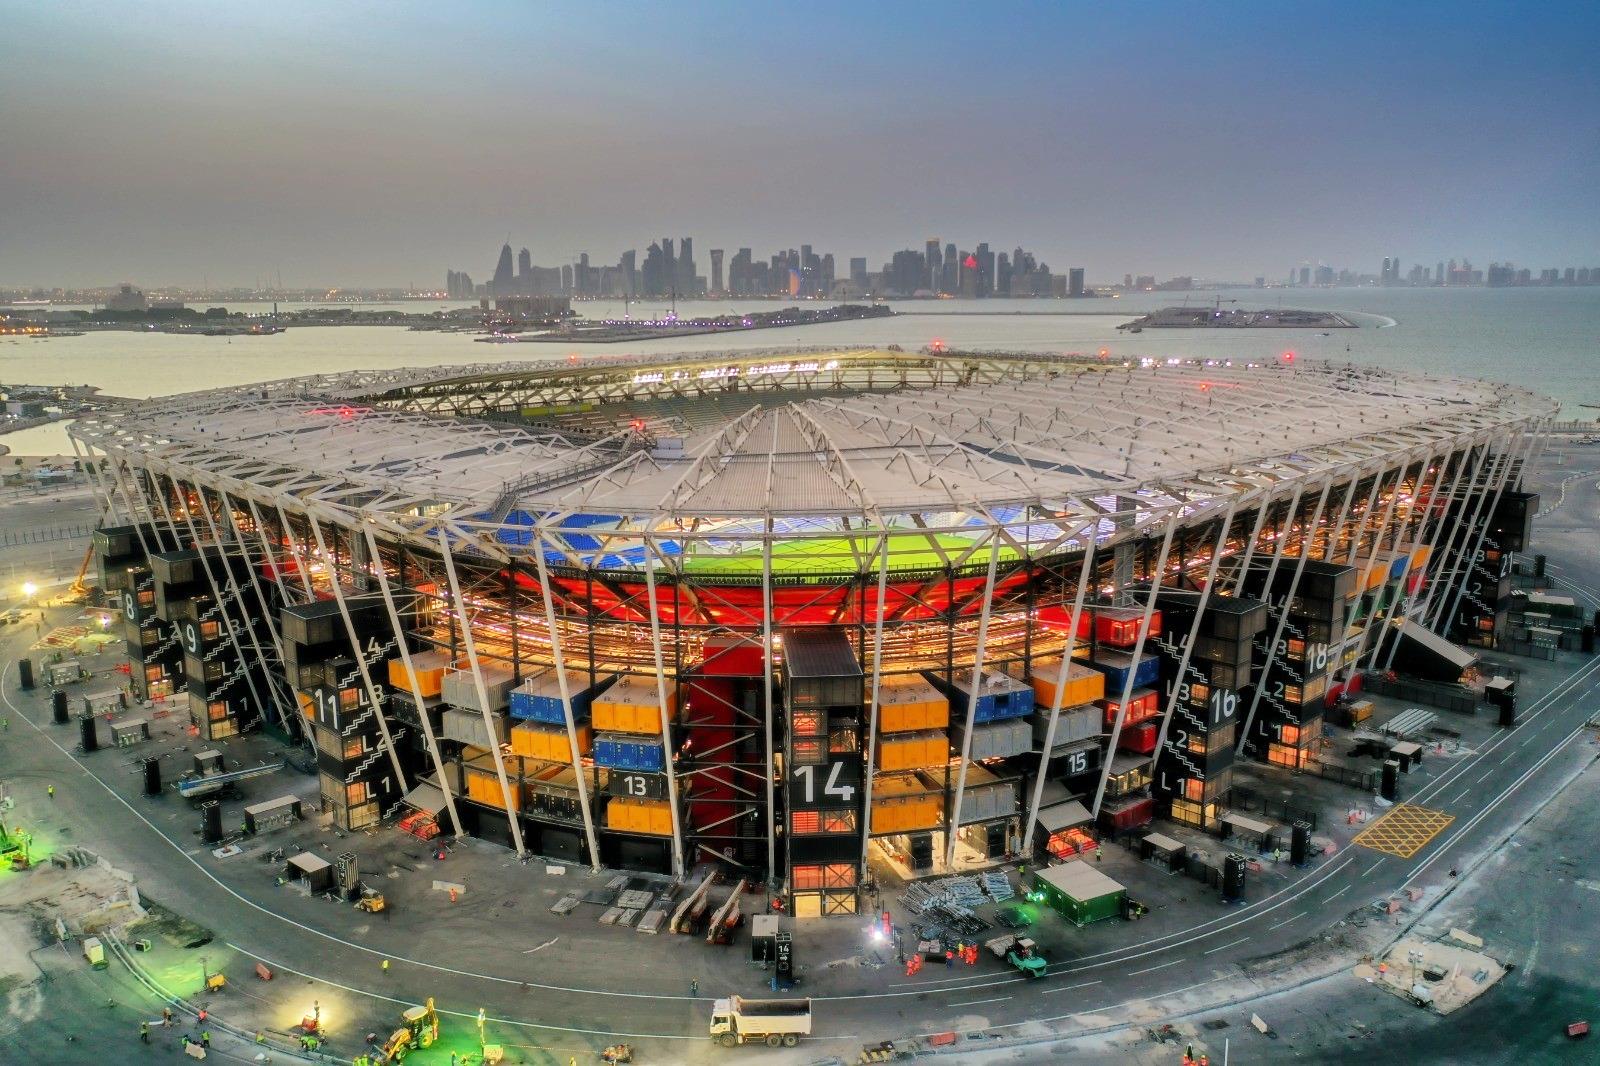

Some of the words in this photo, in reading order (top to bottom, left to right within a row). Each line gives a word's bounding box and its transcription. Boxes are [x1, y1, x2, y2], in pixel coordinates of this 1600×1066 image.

[1501, 551, 1514, 578] 21
[125, 593, 135, 620] 8
[218, 619, 240, 637] L3
[1460, 613, 1480, 627] L1
[186, 623, 197, 653] 9
[161, 660, 183, 677] L1
[1307, 643, 1329, 674] 18
[226, 697, 248, 715] L1
[359, 684, 385, 707] L3
[1212, 688, 1237, 724] 16
[315, 689, 338, 730] 11
[1259, 719, 1282, 741] L1
[362, 731, 388, 753] L2
[1069, 752, 1087, 773] 15
[366, 776, 391, 799] L1
[623, 776, 647, 796] 13
[793, 761, 855, 803] 14
[1161, 771, 1186, 796] L1
[778, 944, 790, 953] 14
